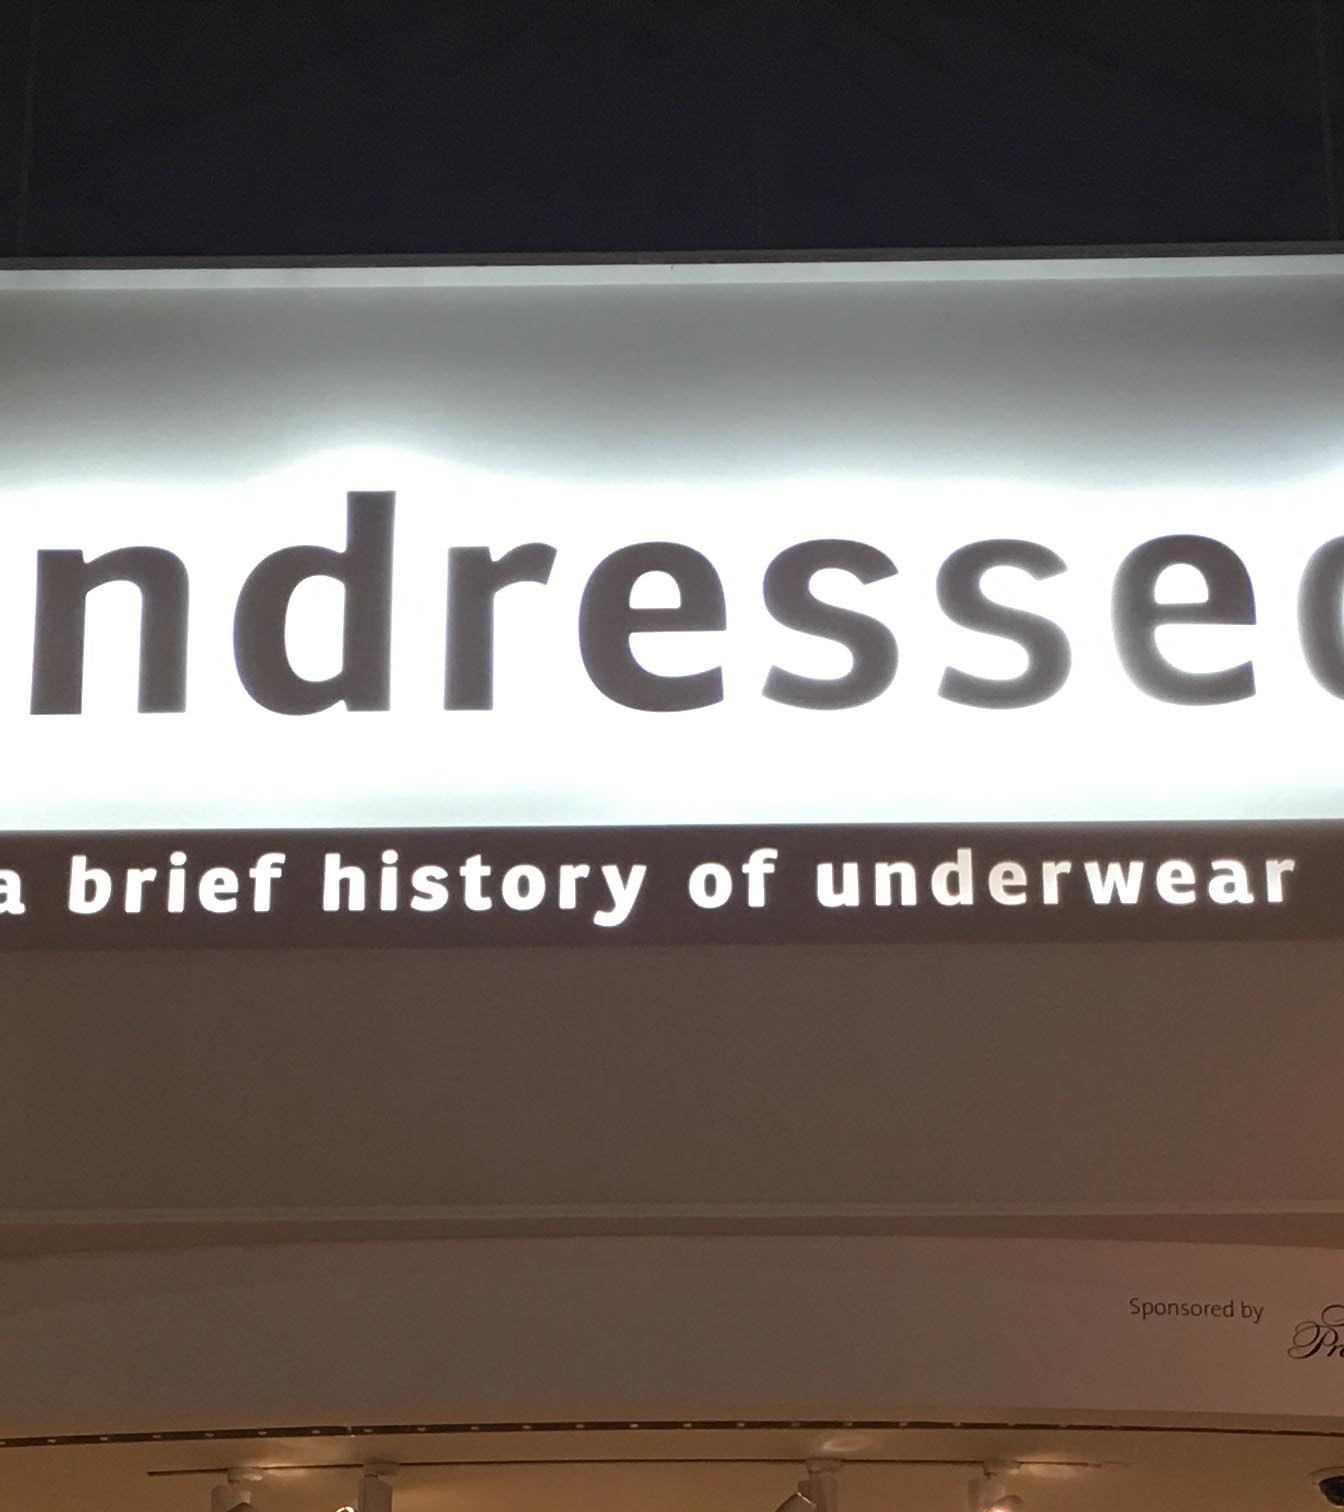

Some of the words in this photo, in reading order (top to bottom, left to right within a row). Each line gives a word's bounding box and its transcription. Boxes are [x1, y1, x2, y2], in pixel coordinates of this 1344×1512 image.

[67, 851, 287, 916] brief
[321, 848, 648, 929] history
[687, 846, 780, 910] of
[815, 847, 1297, 909] underwear
[1128, 1297, 1235, 1321] Sponsored
[1240, 1300, 1264, 1324] by
